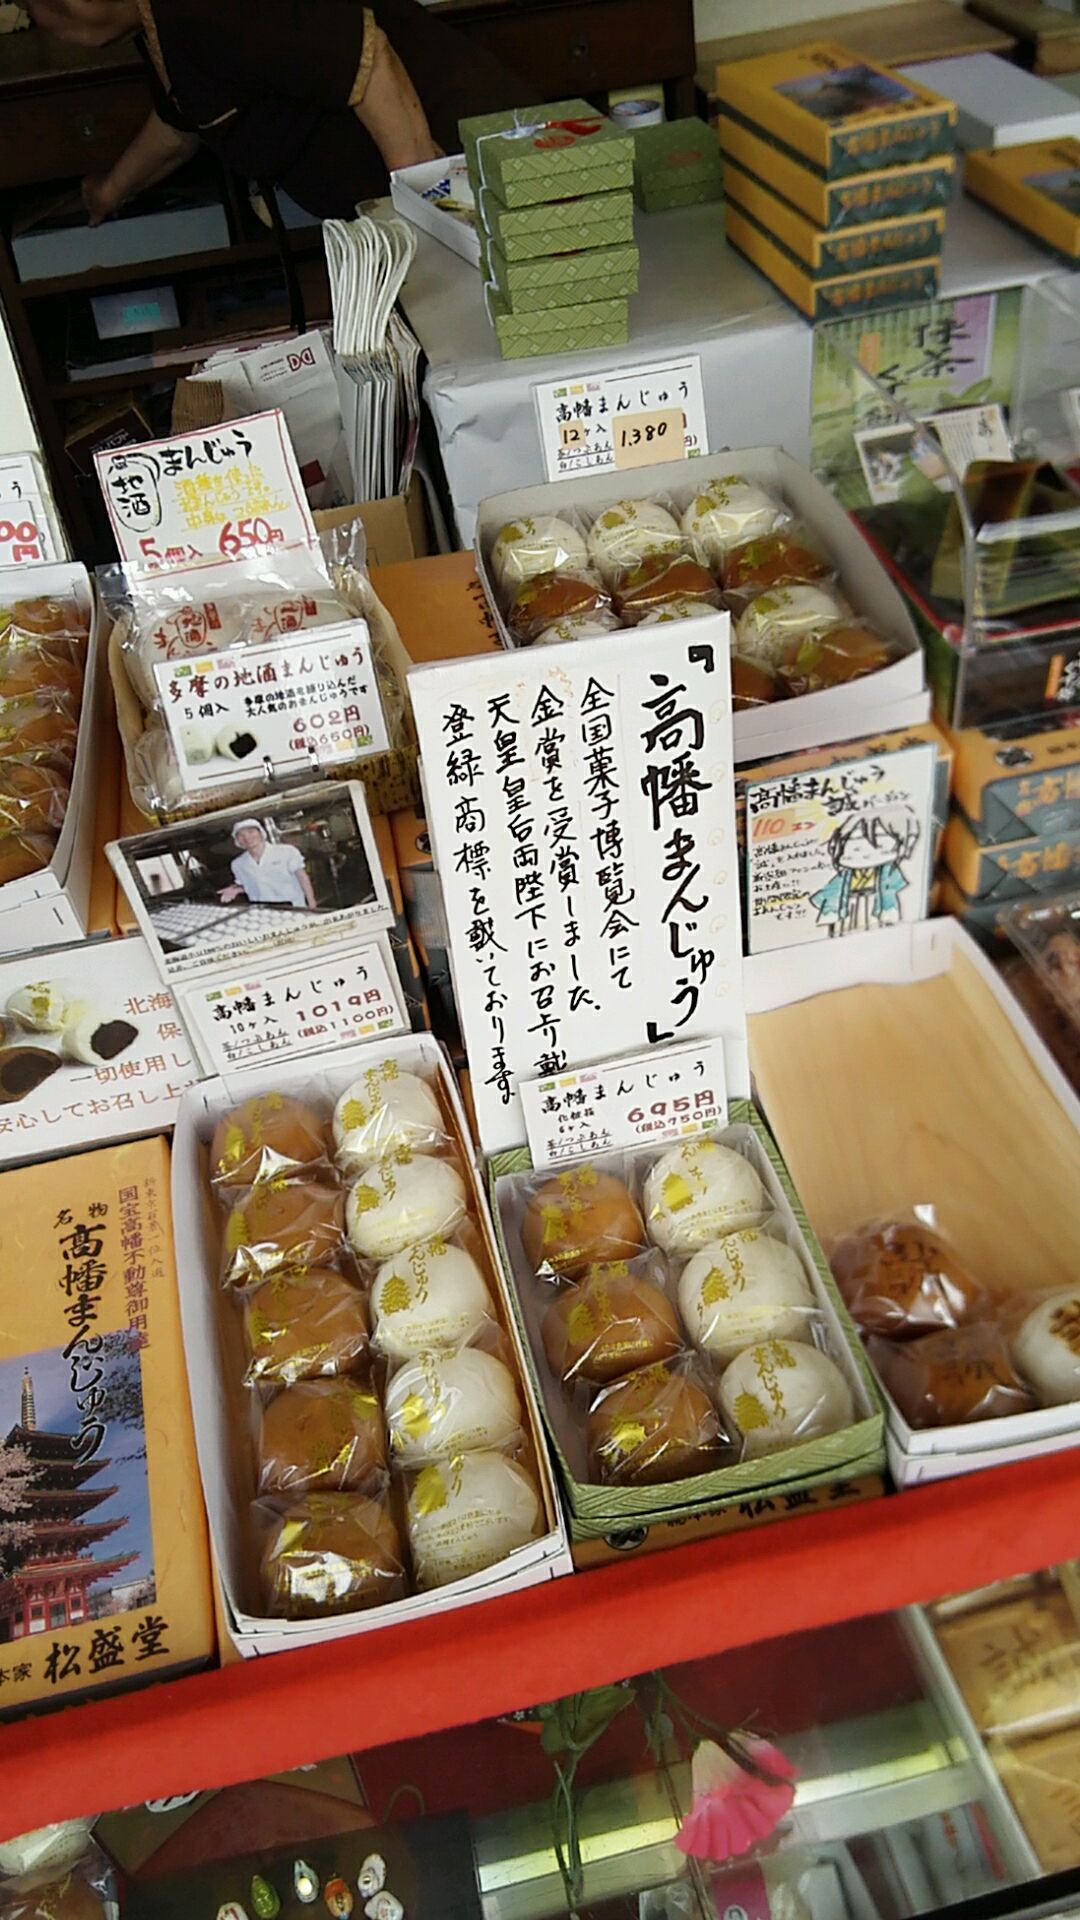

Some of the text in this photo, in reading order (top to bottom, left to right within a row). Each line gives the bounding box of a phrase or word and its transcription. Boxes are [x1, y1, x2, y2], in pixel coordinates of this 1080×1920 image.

[556, 381, 689, 422] 高幡まんじゅう
[158, 429, 254, 476] まんじゅう
[218, 517, 284, 560] 650円
[168, 647, 364, 703] 多摩の地酒まんじゅう
[184, 701, 229, 720] 5個入
[292, 704, 361, 733] 602円
[580, 677, 640, 989] 全国菓子博覧会にて
[212, 966, 369, 1023] 高幡まんじゅう
[296, 988, 382, 1022] 1019円
[70, 1053, 192, 1085] 一切使用し
[541, 1061, 706, 1114] 高幡まんじゅう
[627, 1089, 715, 1123] 695円
[57, 1223, 109, 1470] 高幡まんじゅう
[44, 1615, 171, 1684] 松盛堂
